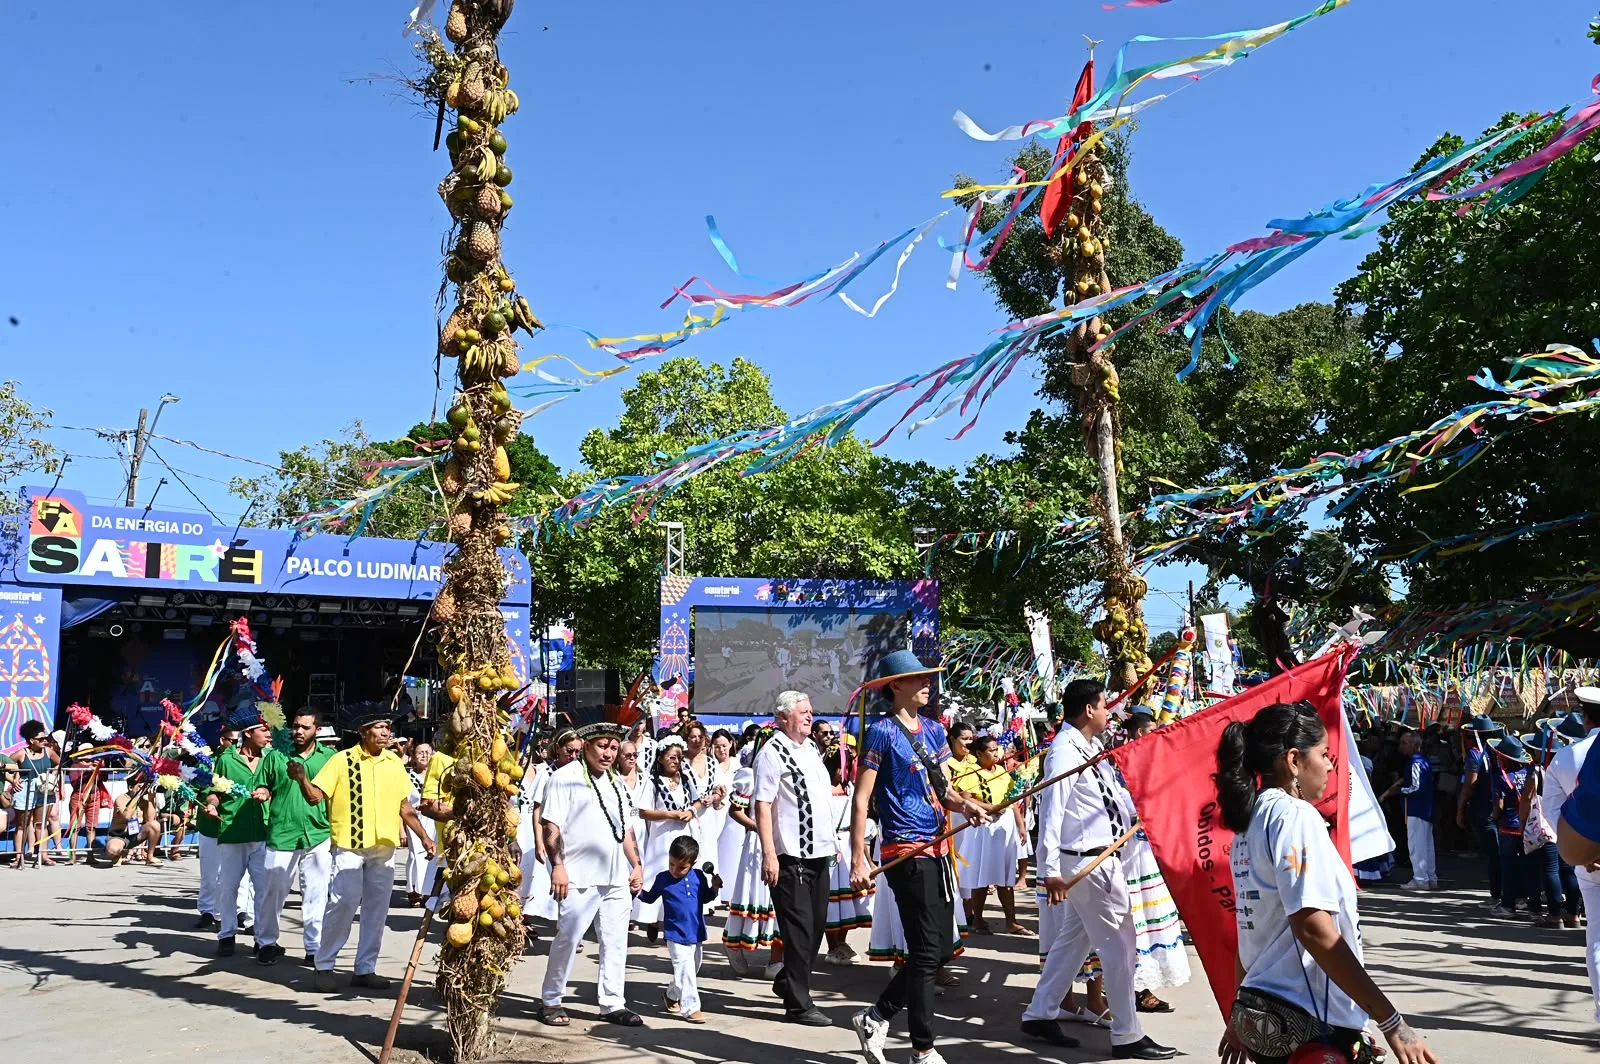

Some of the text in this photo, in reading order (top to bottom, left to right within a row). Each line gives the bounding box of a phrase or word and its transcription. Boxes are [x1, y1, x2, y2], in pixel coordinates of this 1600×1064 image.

[91, 515, 112, 529] DA
[115, 517, 180, 534] ENERGIA
[182, 522, 204, 536] DO
[28, 535, 256, 585] SAIRÉ
[286, 556, 442, 582] PALCO LUDIMAR
[704, 585, 740, 595] equatorial
[1211, 885, 1238, 914] Par
